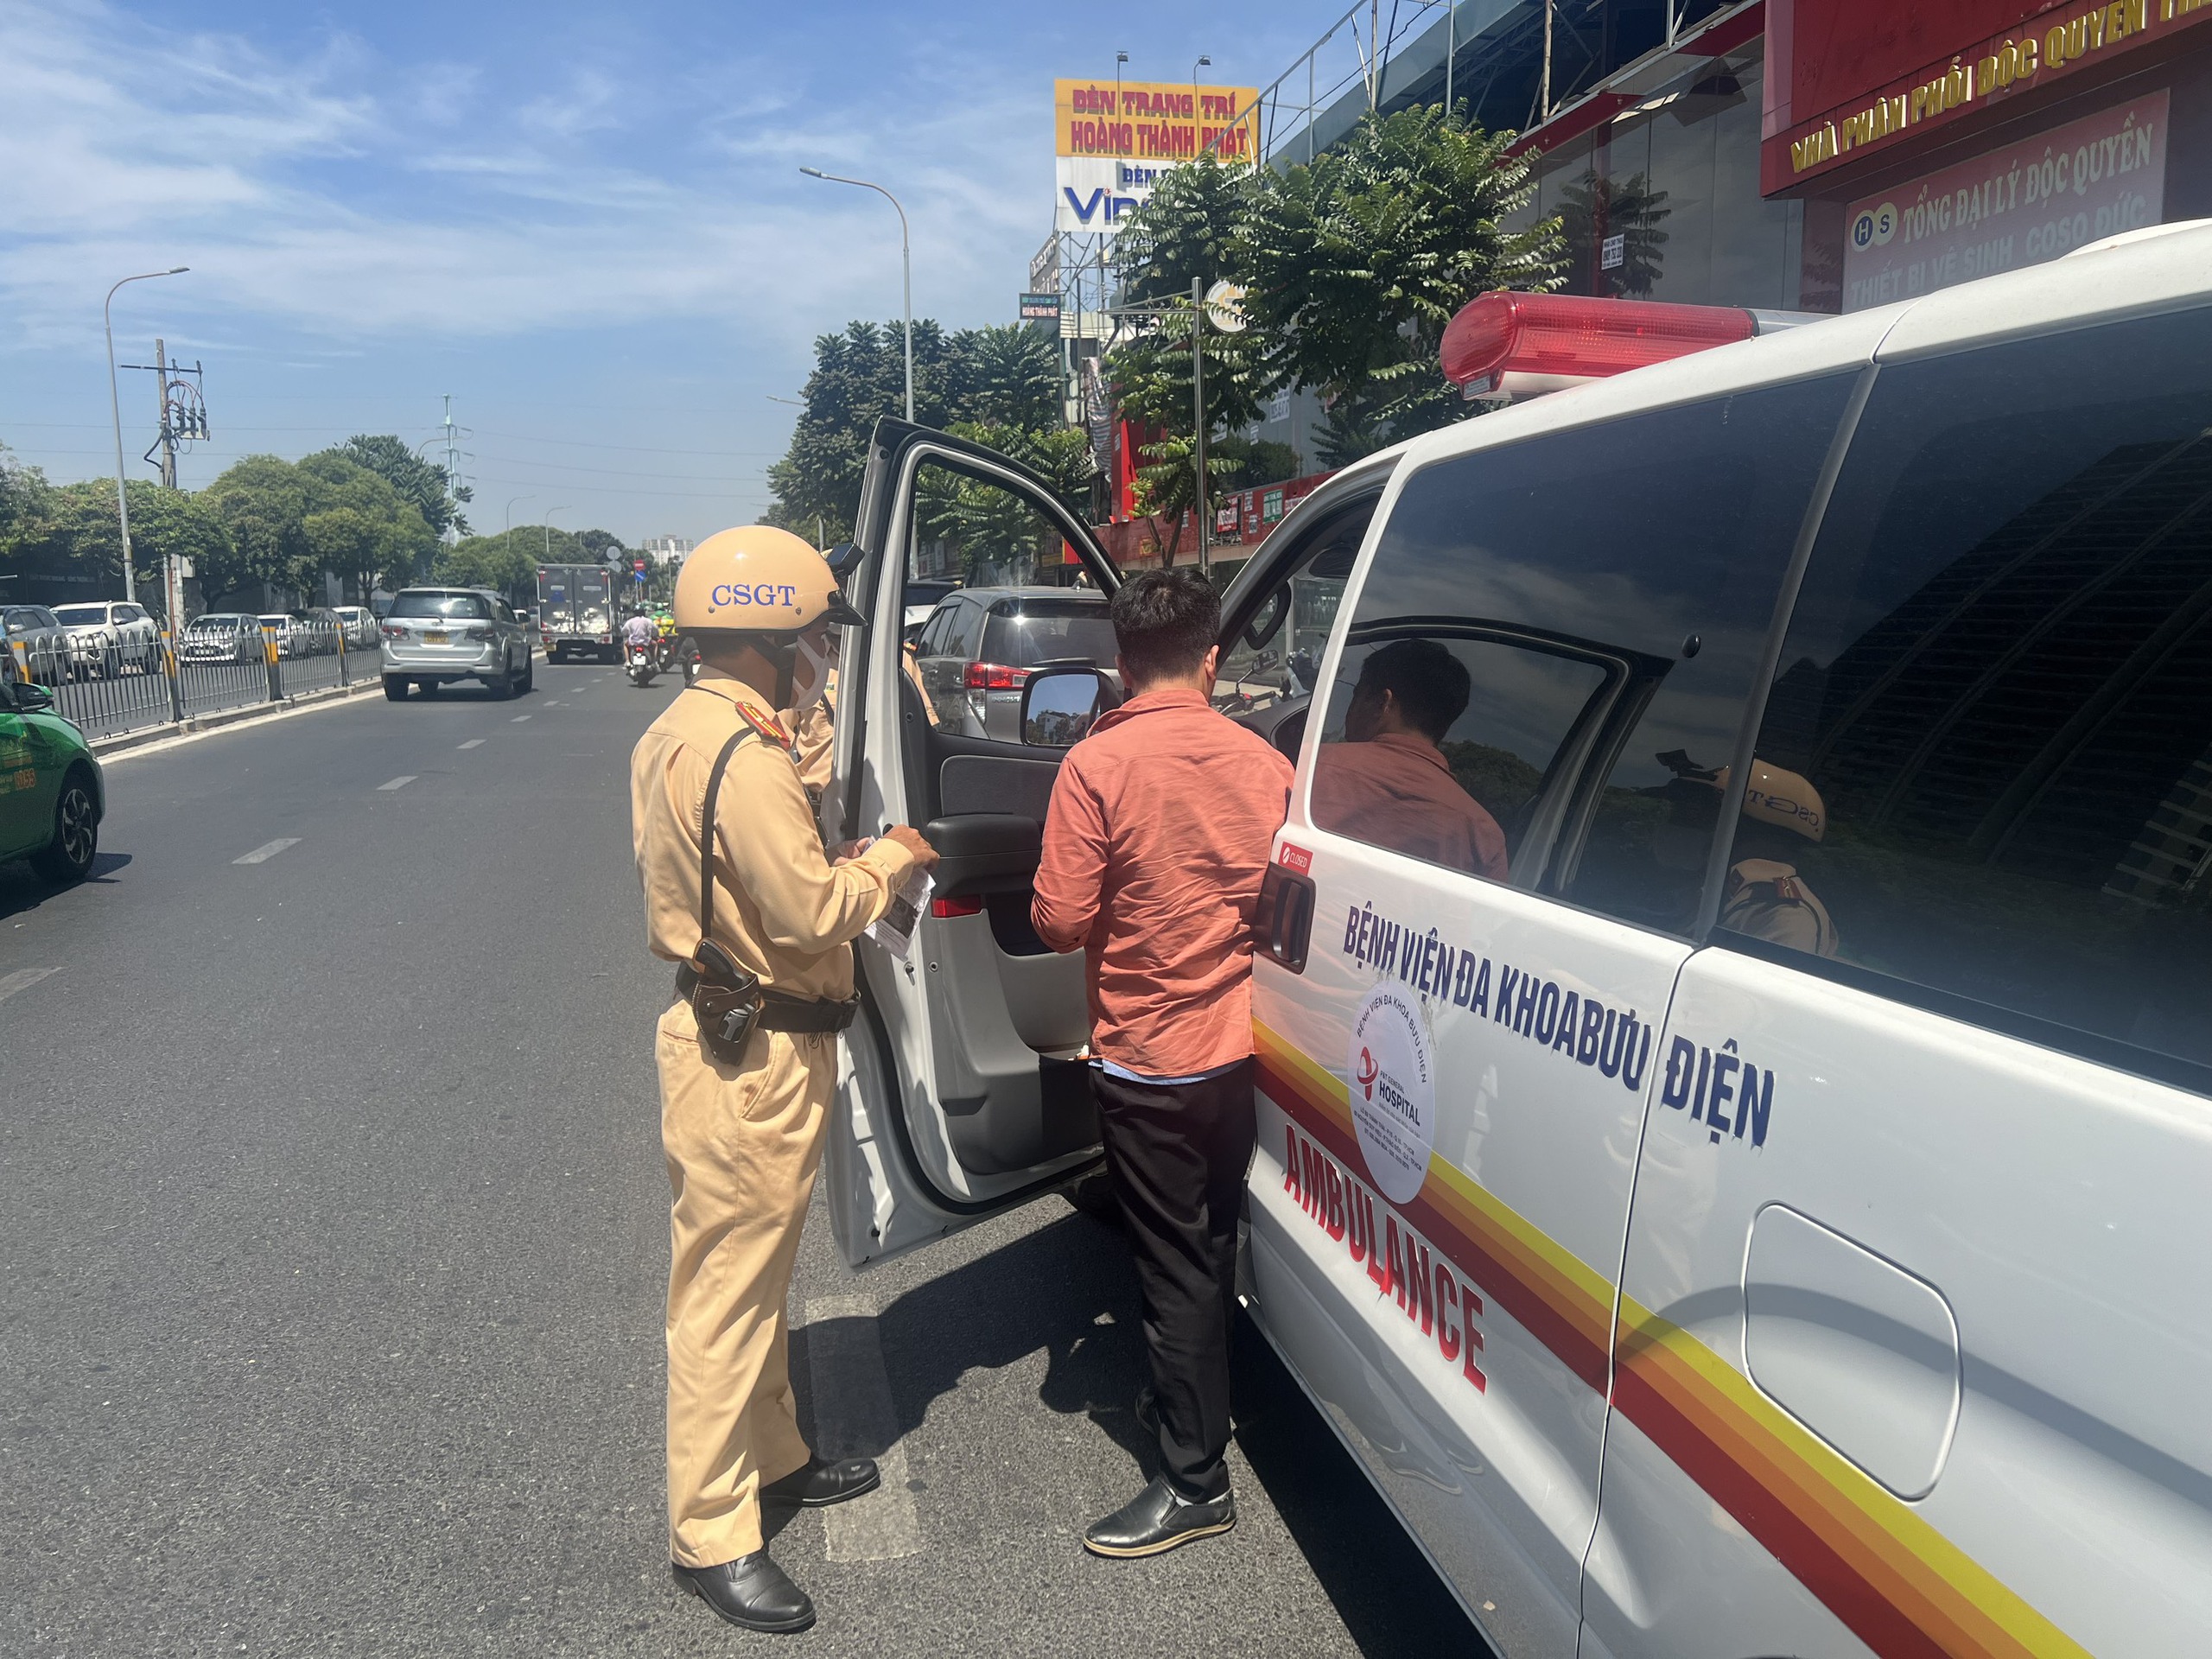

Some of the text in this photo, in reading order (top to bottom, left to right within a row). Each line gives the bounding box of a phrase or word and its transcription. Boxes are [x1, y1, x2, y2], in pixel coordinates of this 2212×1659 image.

[1072, 84, 1236, 120] ĐÈN TRANG TRÍ
[1842, 97, 1907, 153] PHÂN
[1910, 55, 1973, 124] PHỐI
[1976, 39, 2037, 96] ĐỘC
[1071, 117, 1133, 155] HOÀNG
[1136, 119, 1196, 157] THÀNH
[1904, 110, 2153, 245] TỔNG ĐẠI LÝ ĐỘC QUYỀN
[1858, 213, 1890, 243] H S
[1851, 259, 1904, 307] THIẾT
[1965, 234, 2013, 276] SINH
[711, 583, 796, 607] CSGT
[1289, 852, 1308, 868] CLOSED
[1343, 900, 1401, 972] BỆNH
[1400, 927, 1455, 1003] VIỆN
[1454, 950, 1491, 1019] ĐA
[1661, 1034, 1776, 1147] ĐIỆN
[1383, 995, 1392, 1006] ĐA
[1393, 996, 1409, 1022] KHOA
[1379, 1080, 1421, 1127] HOSPITAL
[1284, 1123, 1488, 1395] AMBULANCE
